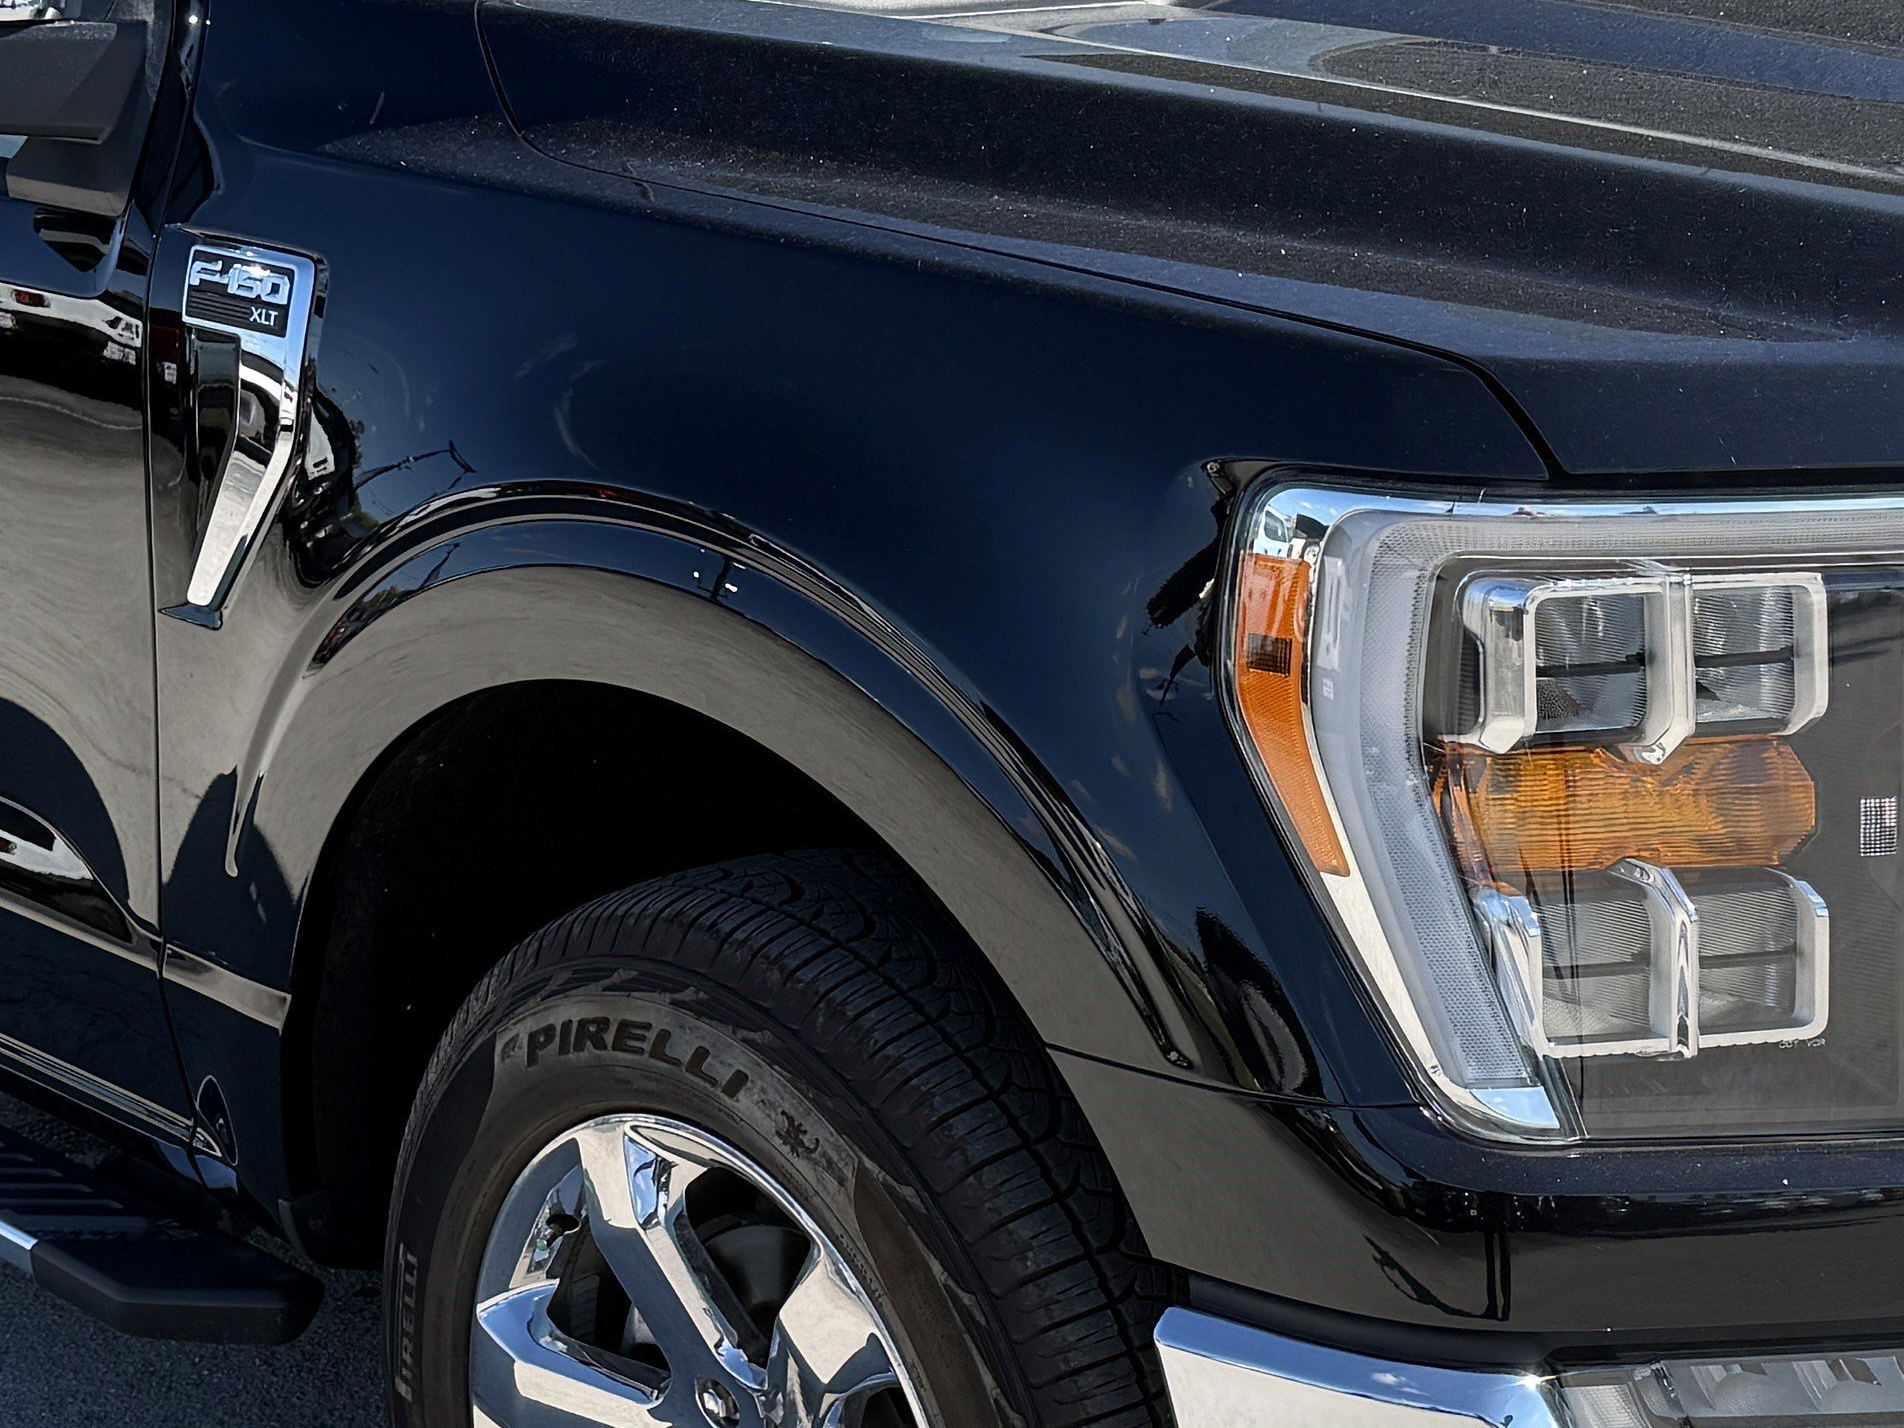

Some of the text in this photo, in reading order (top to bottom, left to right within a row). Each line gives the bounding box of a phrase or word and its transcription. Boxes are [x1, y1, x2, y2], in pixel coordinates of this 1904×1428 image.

[189, 260, 291, 305] F-150
[249, 306, 279, 326] XLT
[526, 1015, 750, 1100] PIRELLI
